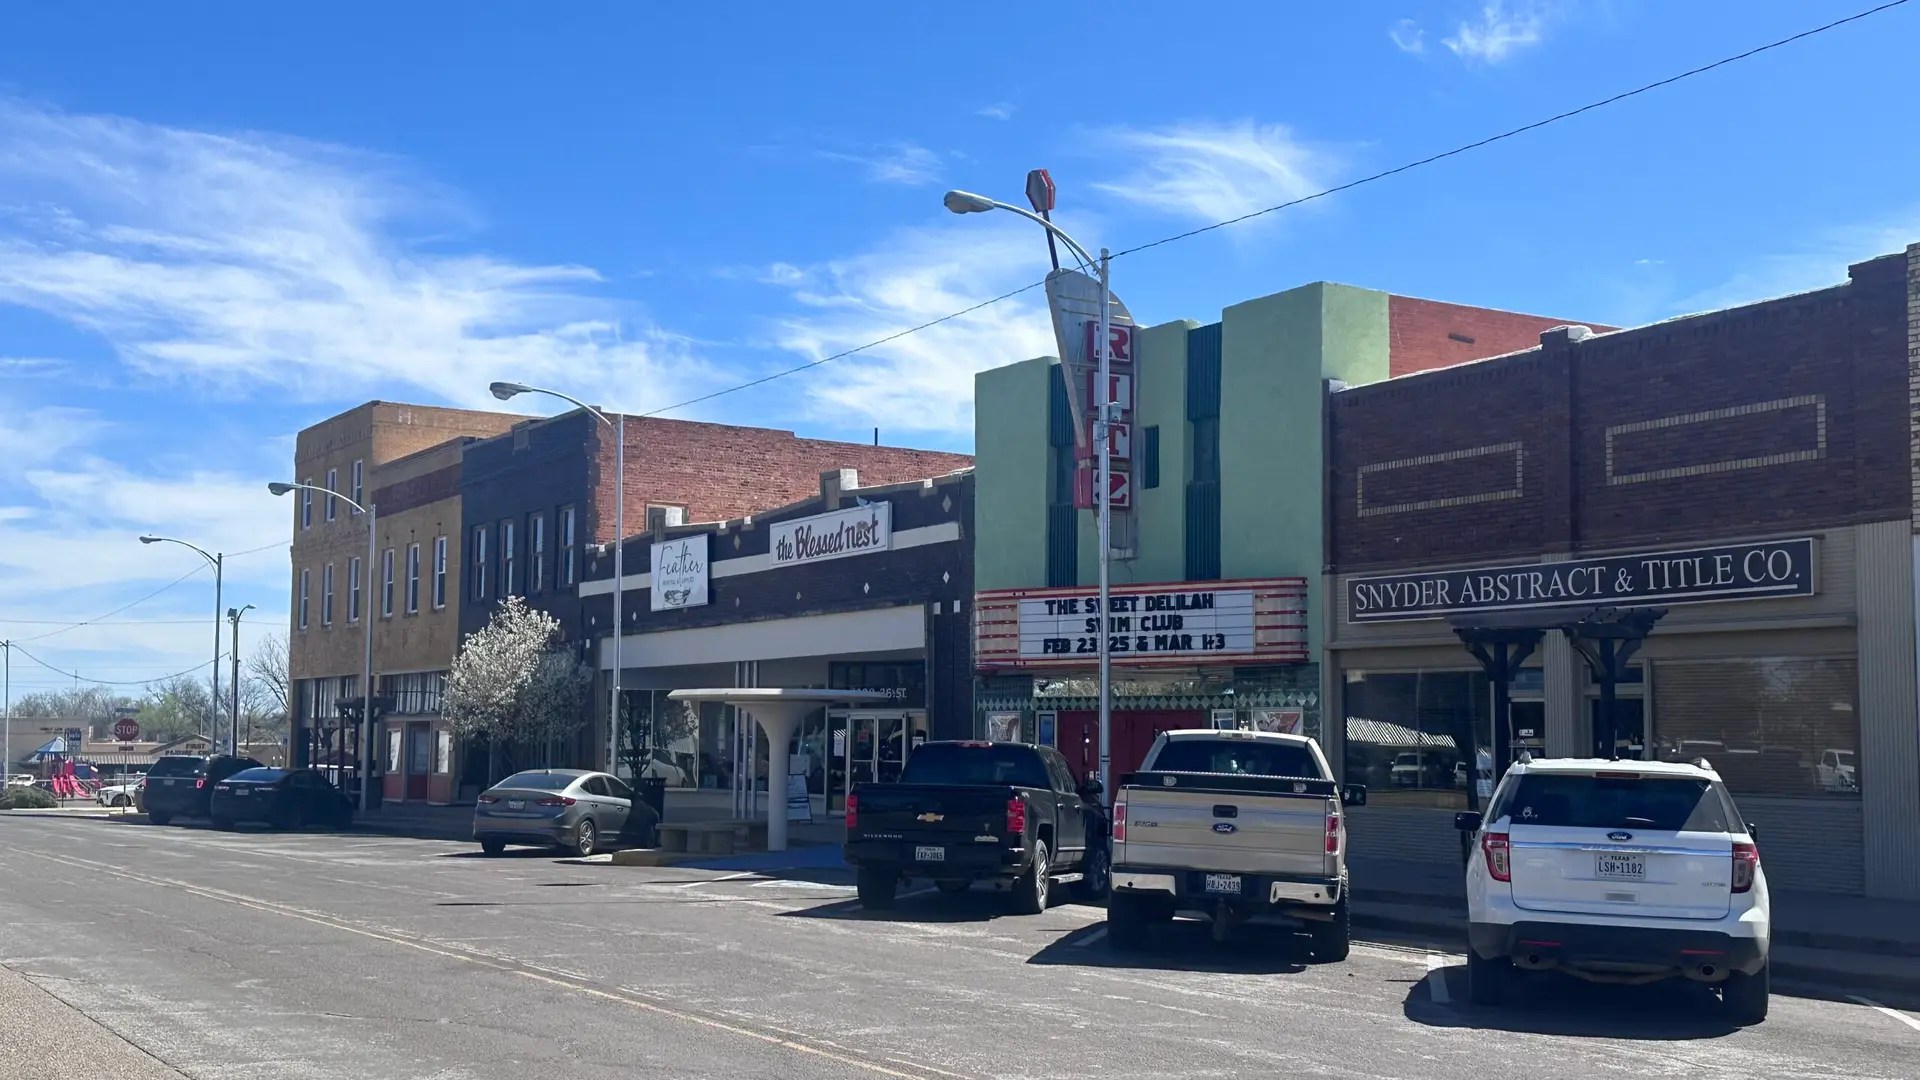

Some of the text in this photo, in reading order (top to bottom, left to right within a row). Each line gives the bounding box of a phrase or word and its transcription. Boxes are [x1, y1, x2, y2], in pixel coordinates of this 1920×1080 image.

[774, 513, 880, 561] the Blessed nest
[658, 541, 704, 591] Feather
[1355, 549, 1800, 611] SNYDER ABSTRACT & TITLE CO.
[1045, 599, 1079, 616] THE
[1145, 593, 1214, 612] DELILAH
[1140, 614, 1183, 632] CLUB
[1043, 638, 1071, 654] FEB
[1154, 633, 1193, 651] MAR
[116, 725, 139, 735] STOP
